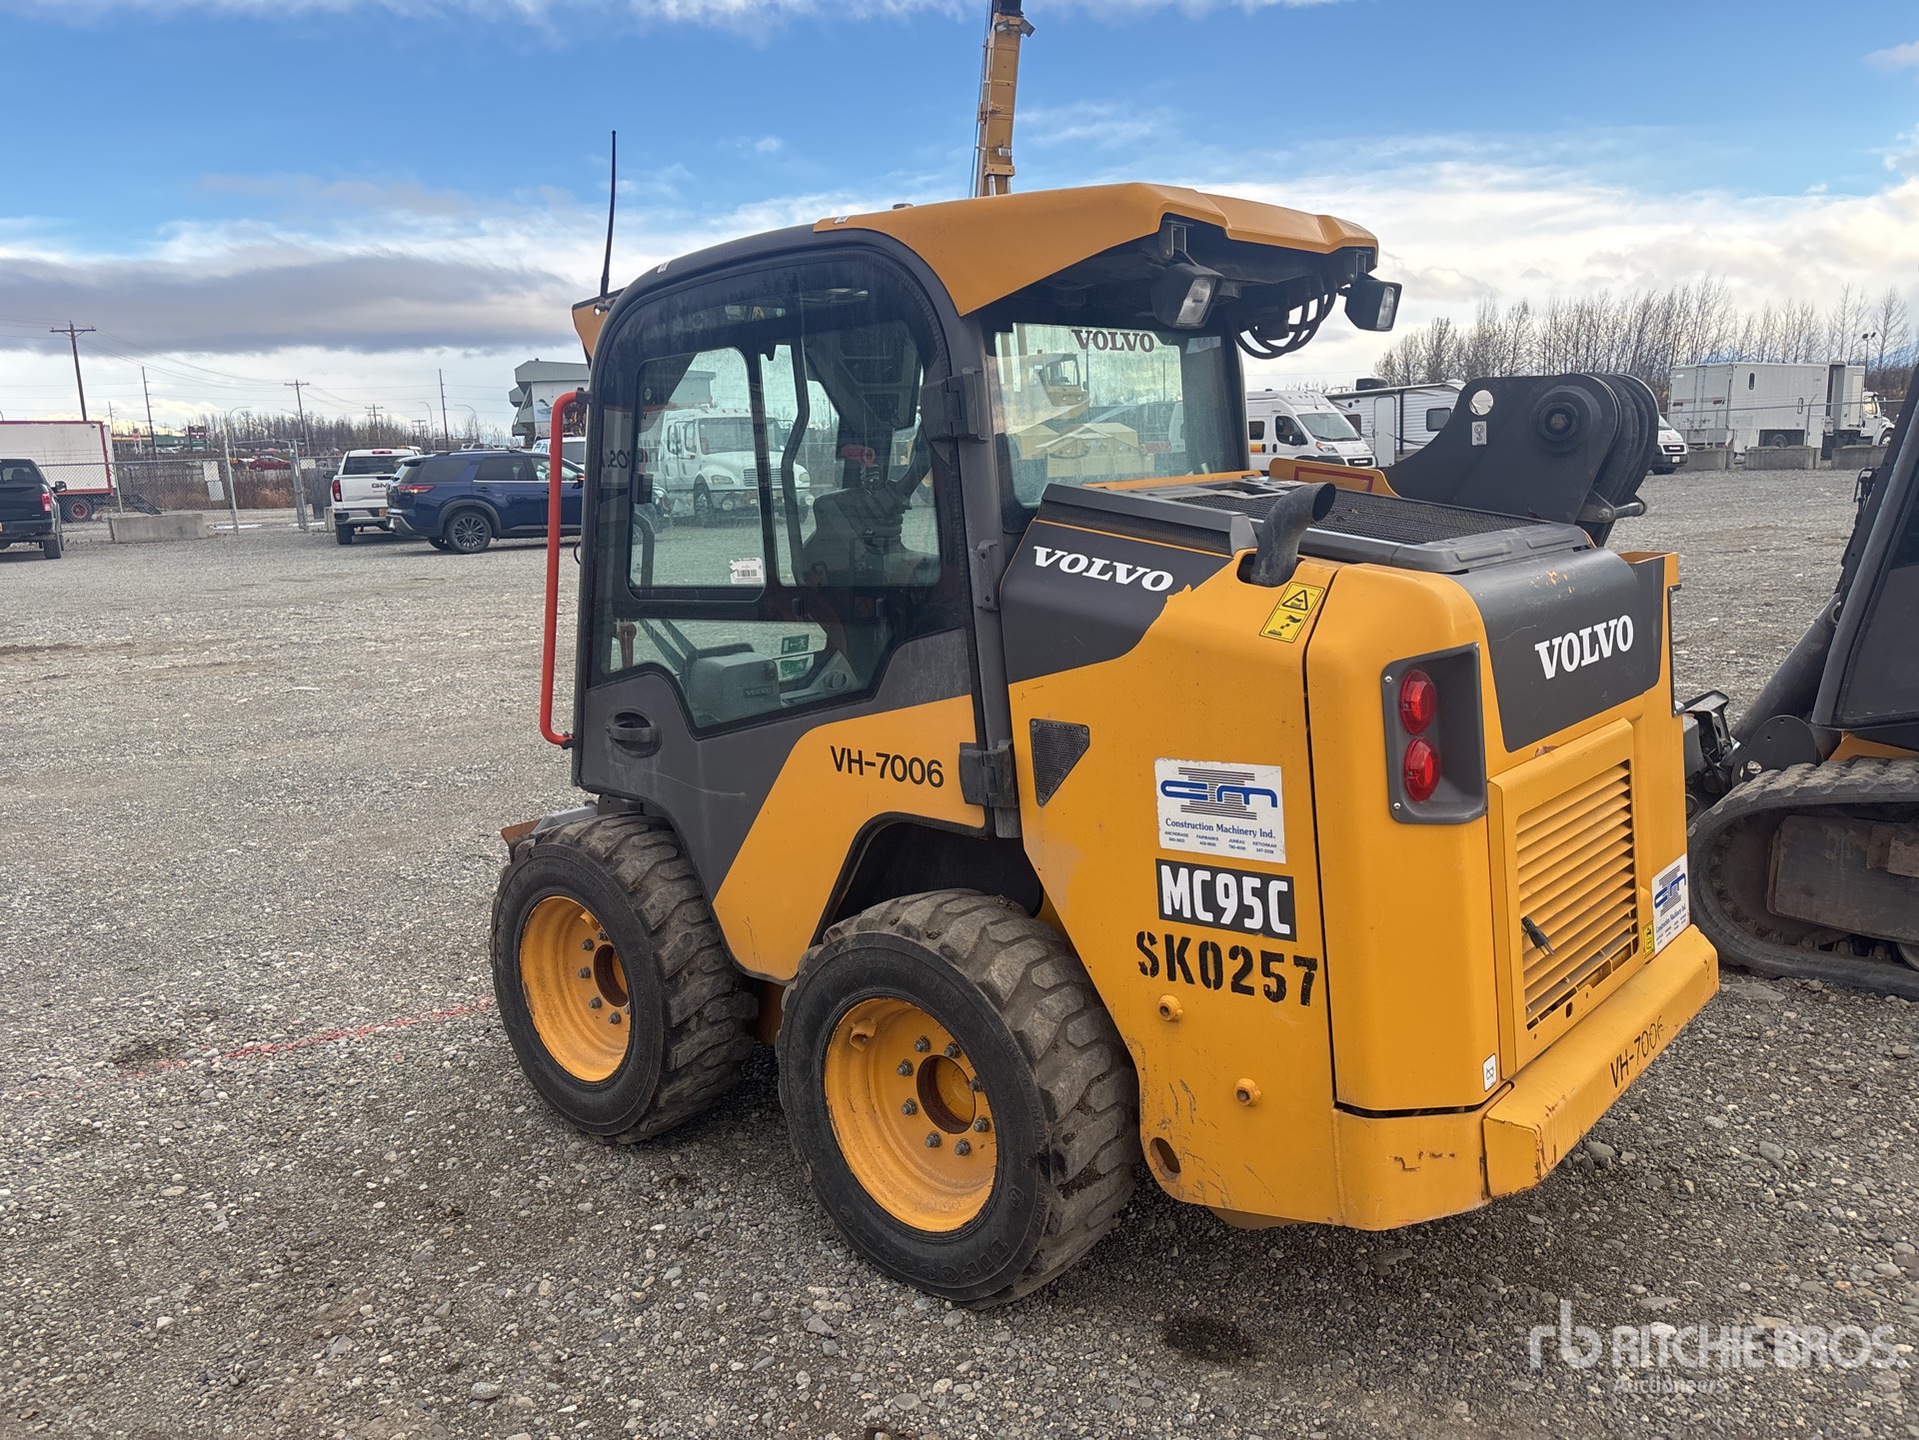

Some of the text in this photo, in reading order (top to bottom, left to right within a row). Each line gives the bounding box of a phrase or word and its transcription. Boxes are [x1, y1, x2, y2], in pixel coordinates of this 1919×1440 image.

[1071, 329, 1155, 353] VOLVO
[1033, 545, 1174, 592] VOLVO
[1534, 614, 1634, 680] VOLVO
[829, 745, 945, 788] VH-7006
[1165, 817, 1276, 839] Construction Machinery Ind.
[1160, 864, 1291, 935] MC95C
[1135, 930, 1318, 1007] SK0257
